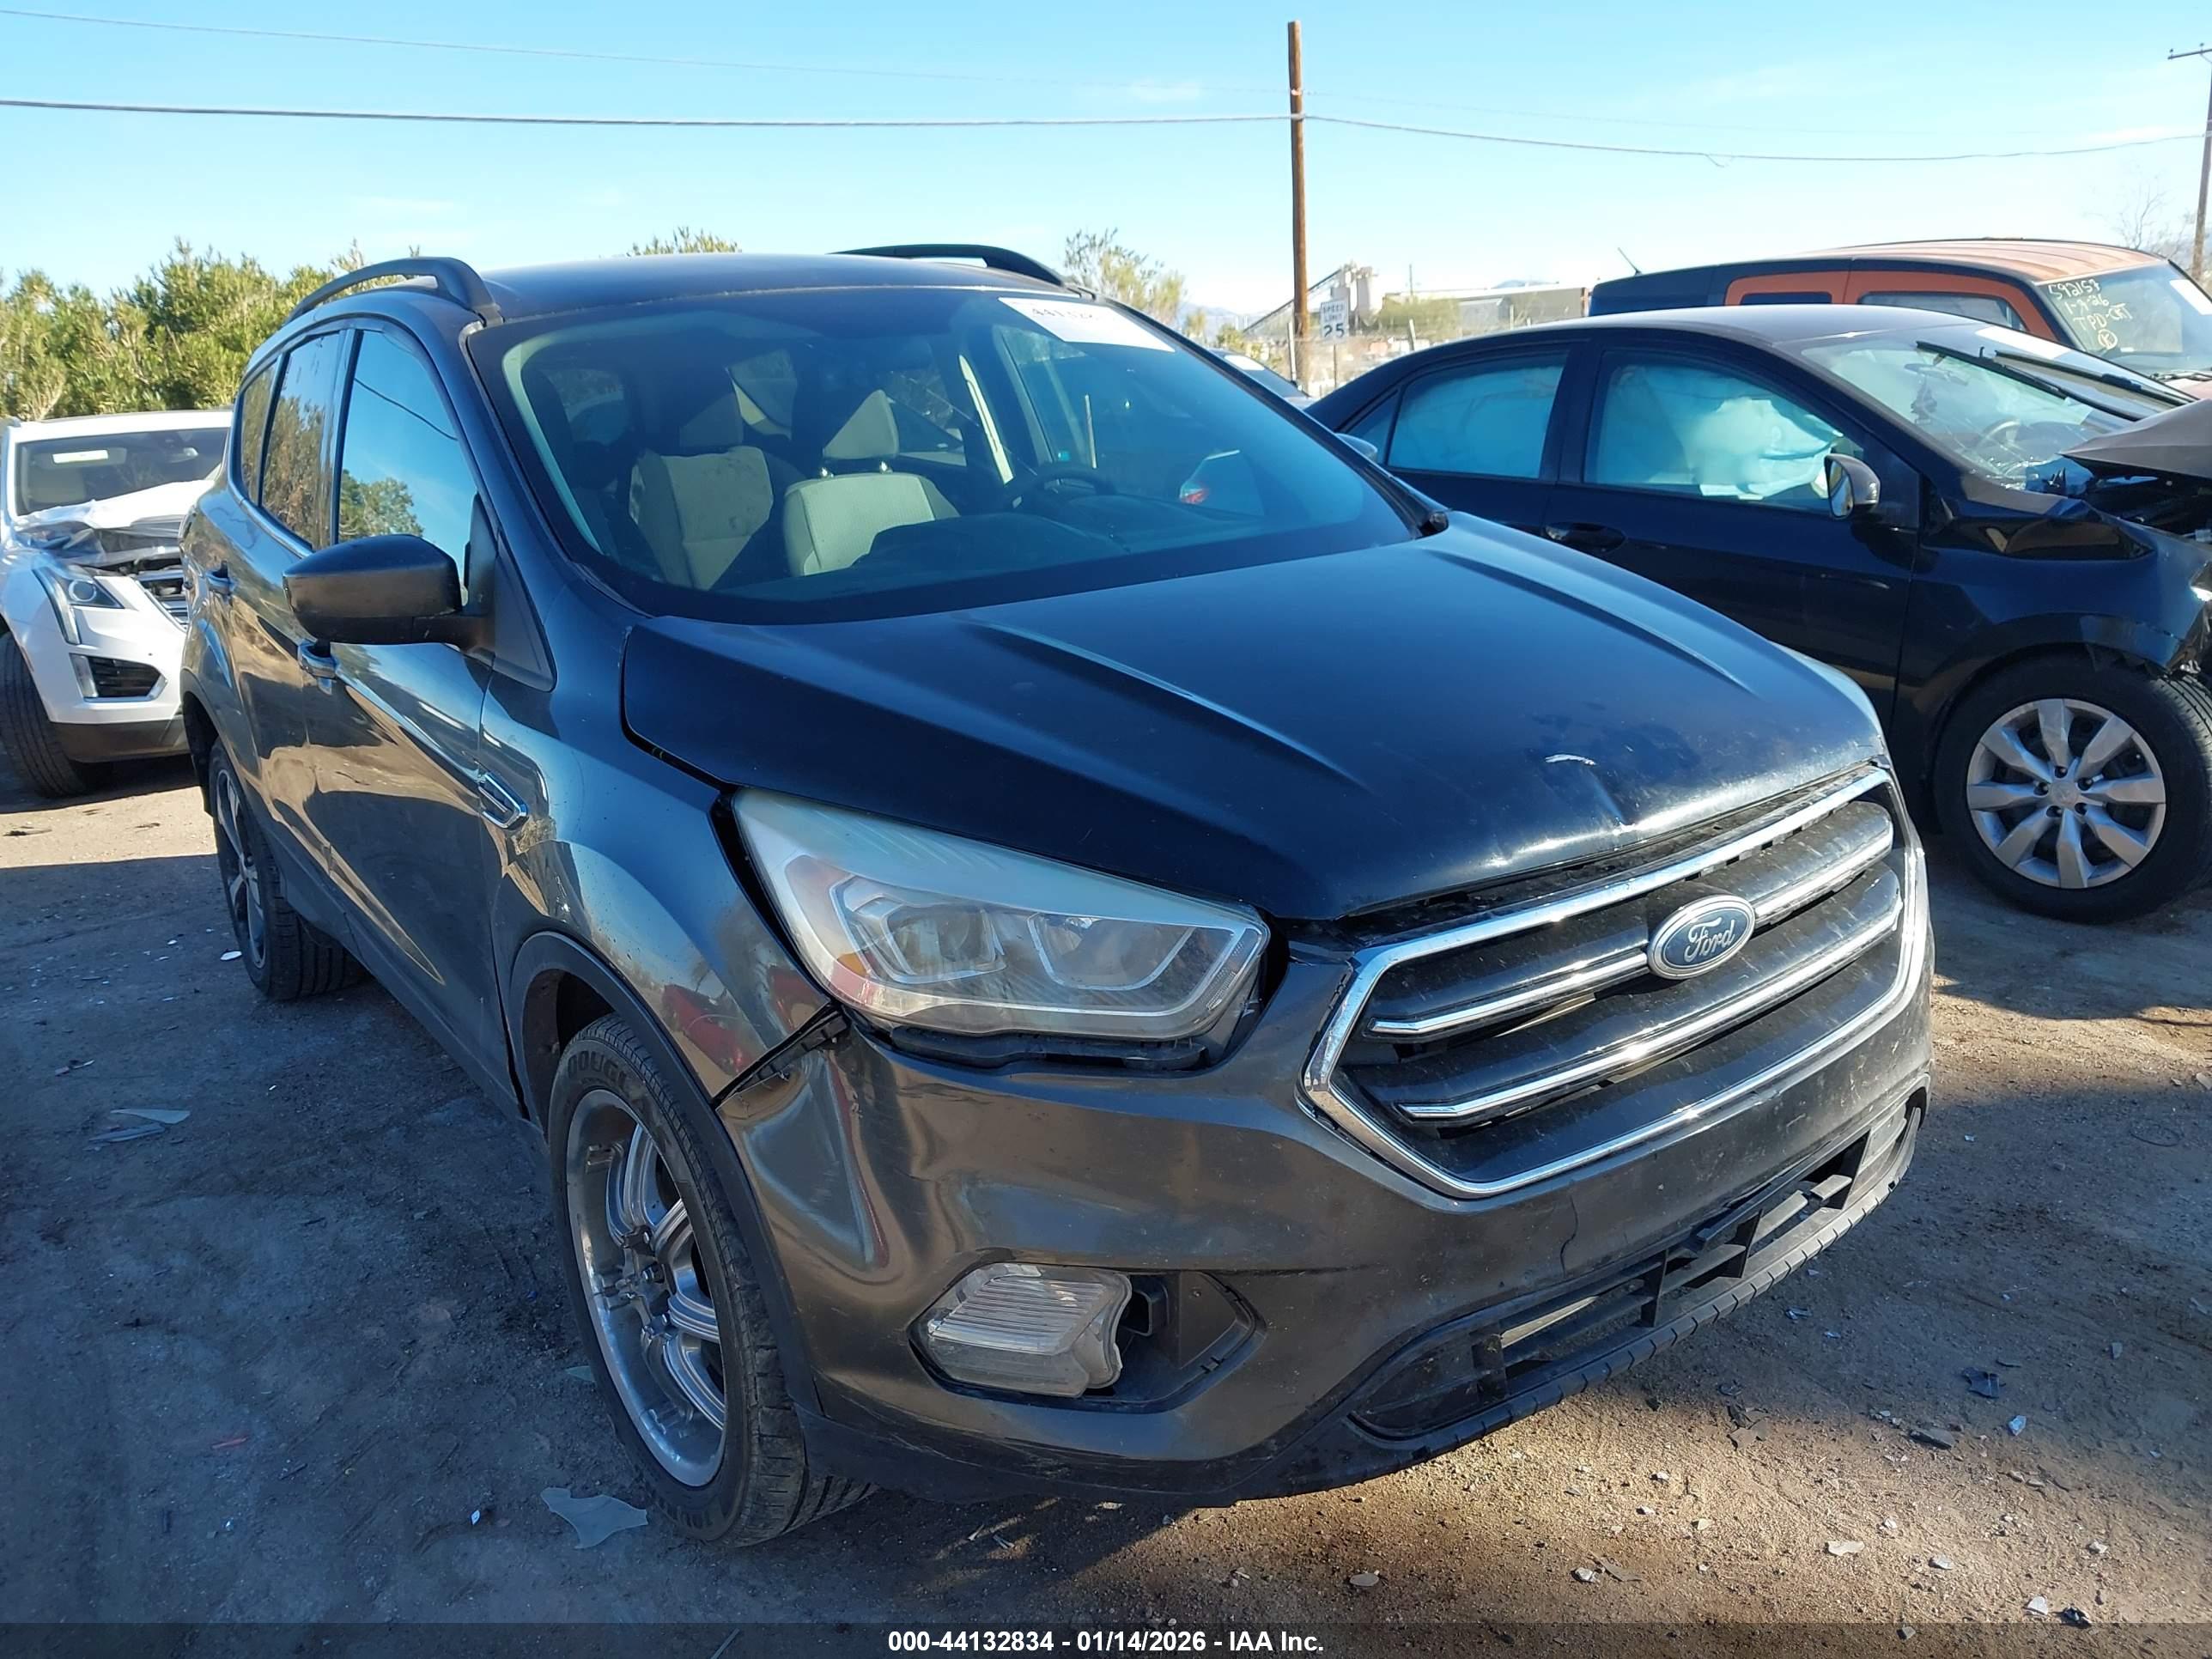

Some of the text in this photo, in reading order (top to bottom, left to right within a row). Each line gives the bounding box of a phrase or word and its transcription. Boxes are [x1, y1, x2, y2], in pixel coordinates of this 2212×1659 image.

[2048, 278, 2100, 300] 592157
[1323, 322, 1345, 337] 25
[1684, 917, 1735, 962] Ford
